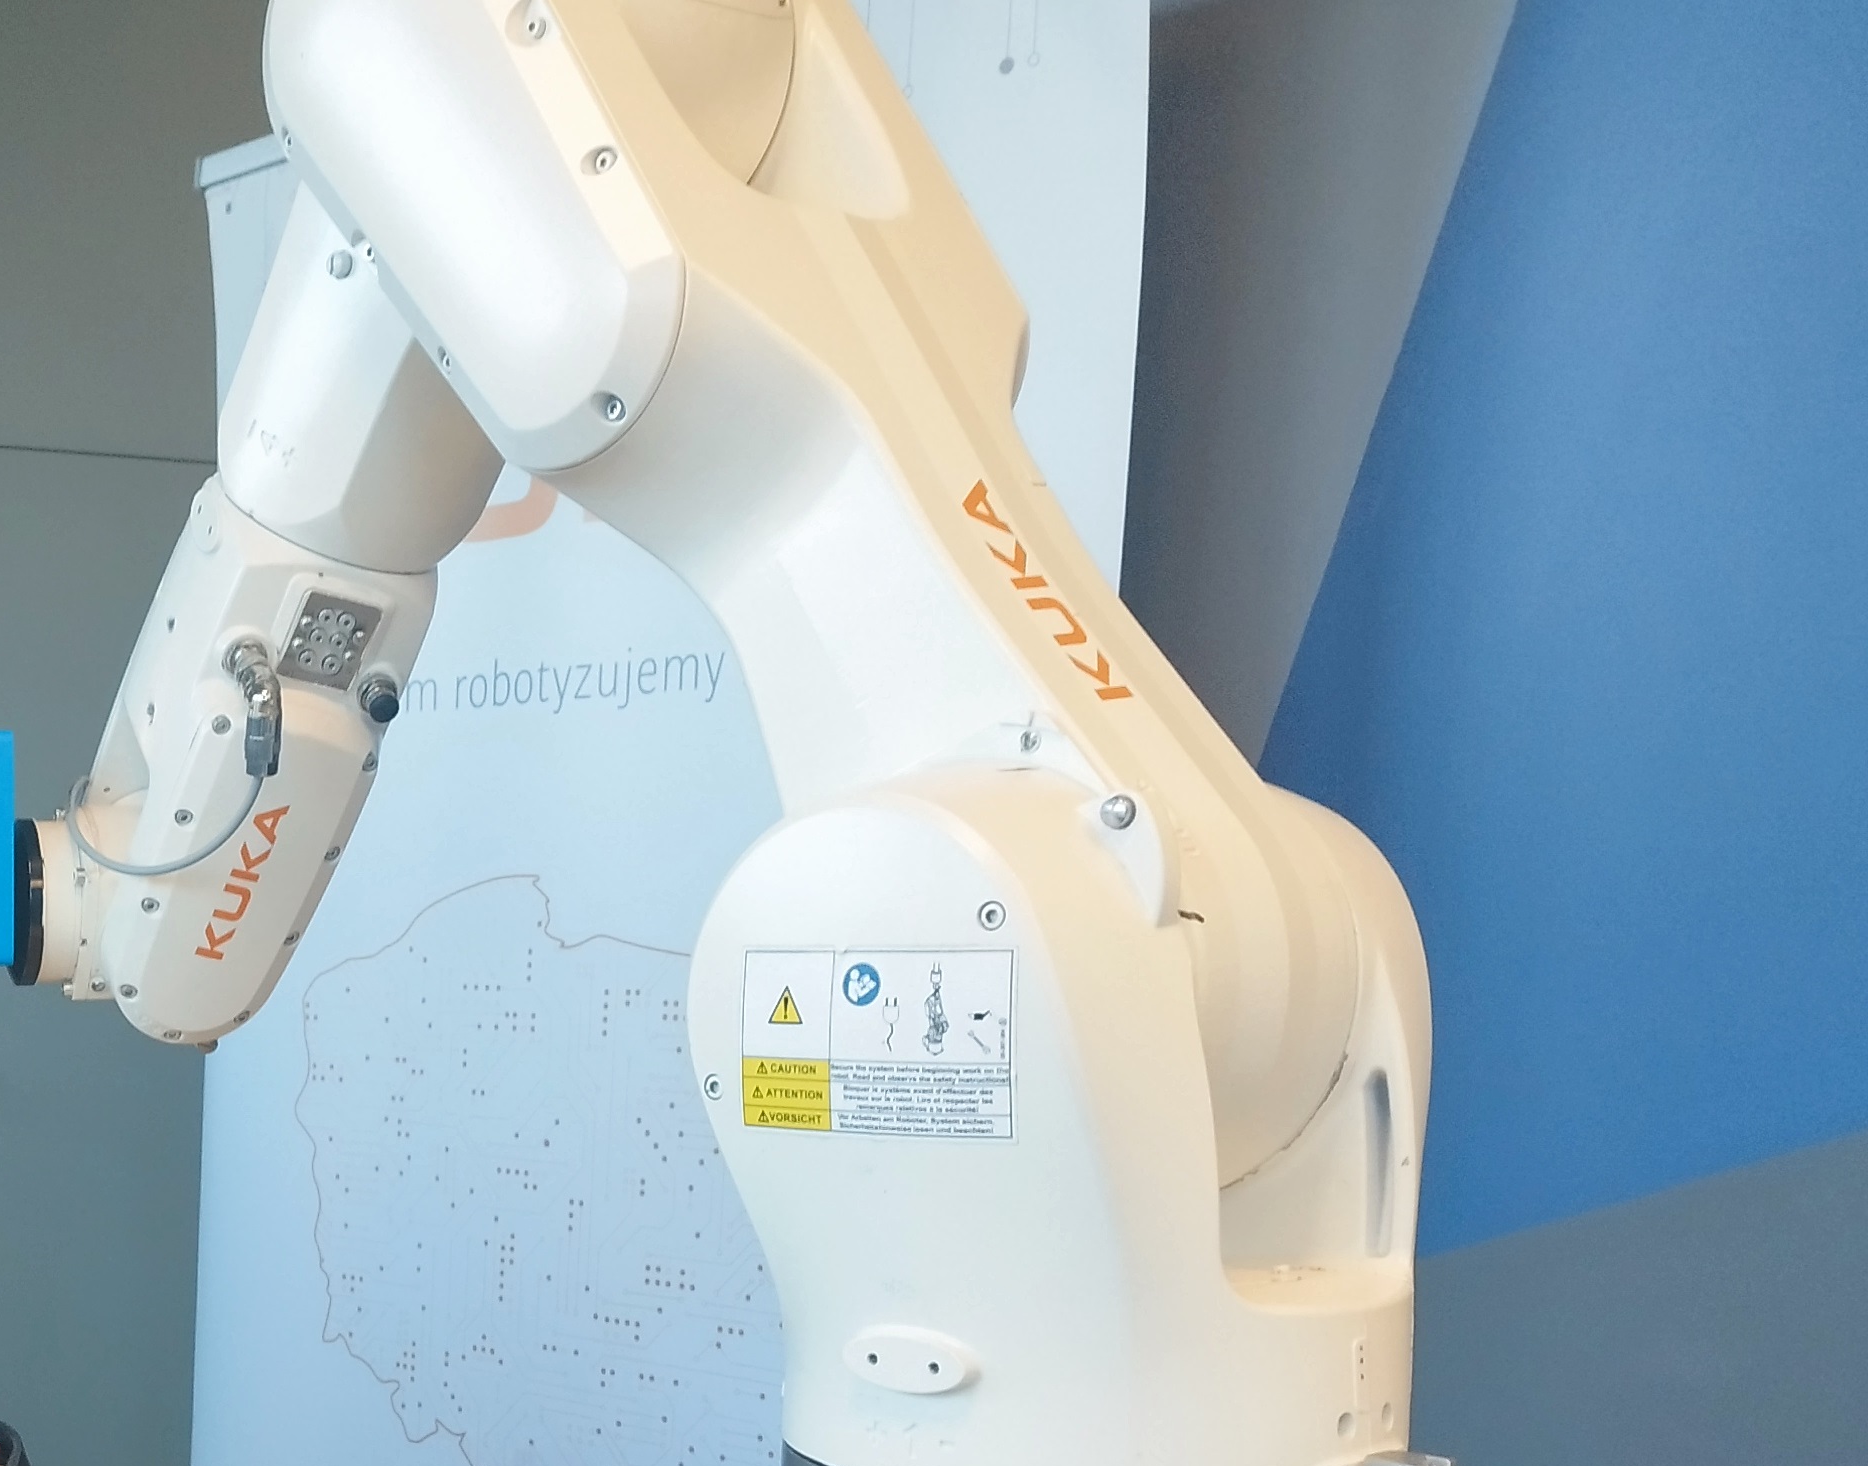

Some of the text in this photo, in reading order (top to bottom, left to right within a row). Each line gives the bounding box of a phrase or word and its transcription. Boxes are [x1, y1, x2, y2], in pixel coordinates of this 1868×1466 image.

[962, 478, 1133, 700] KUKA
[454, 646, 725, 714] robotyzujemy
[194, 804, 291, 960] KUKA
[770, 1062, 817, 1075] CAUTION
[765, 1087, 823, 1100] ATTENTION
[768, 1111, 822, 1125] VORSICHT
